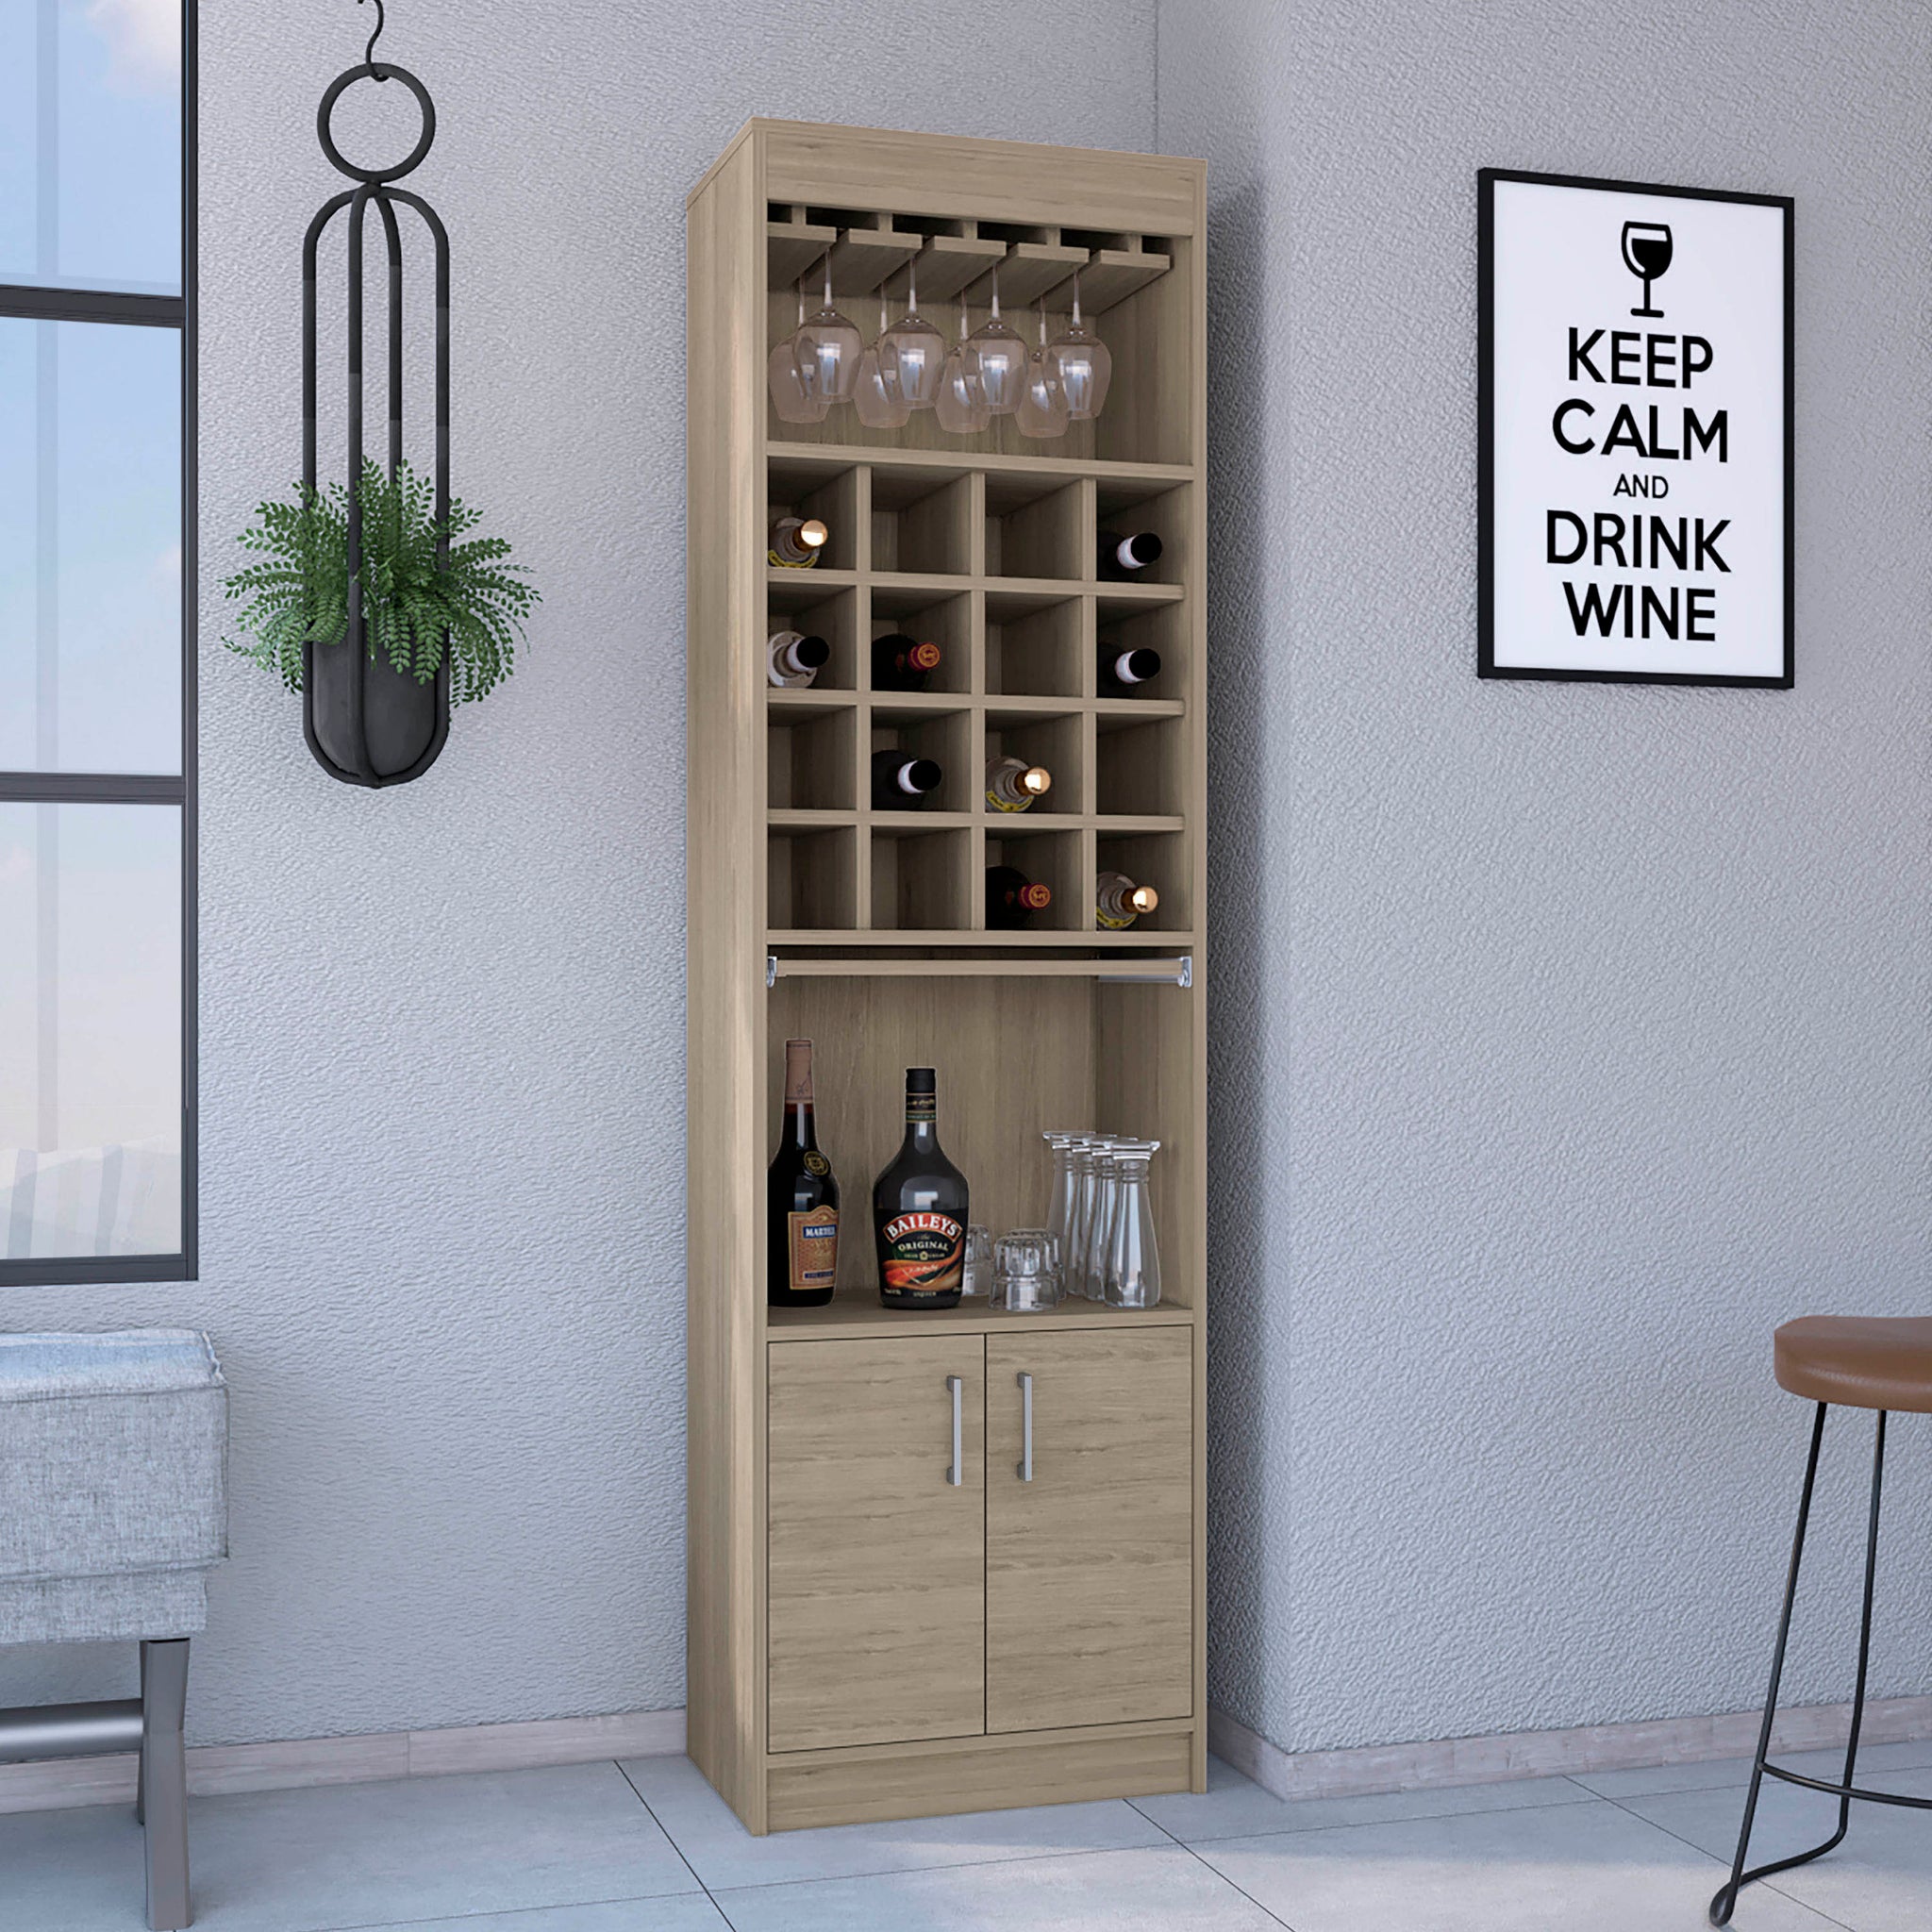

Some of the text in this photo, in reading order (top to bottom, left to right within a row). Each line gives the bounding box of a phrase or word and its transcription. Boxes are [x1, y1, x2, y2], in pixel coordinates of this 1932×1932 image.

[1569, 327, 1713, 389] KEEP
[1553, 399, 1727, 462] CALM
[1613, 474, 1668, 498] AND
[1547, 510, 1731, 573] DRINK
[1562, 582, 1715, 641] WINE
[887, 1214, 958, 1238] BAILEYS
[897, 1241, 949, 1252] ORIGINAL
